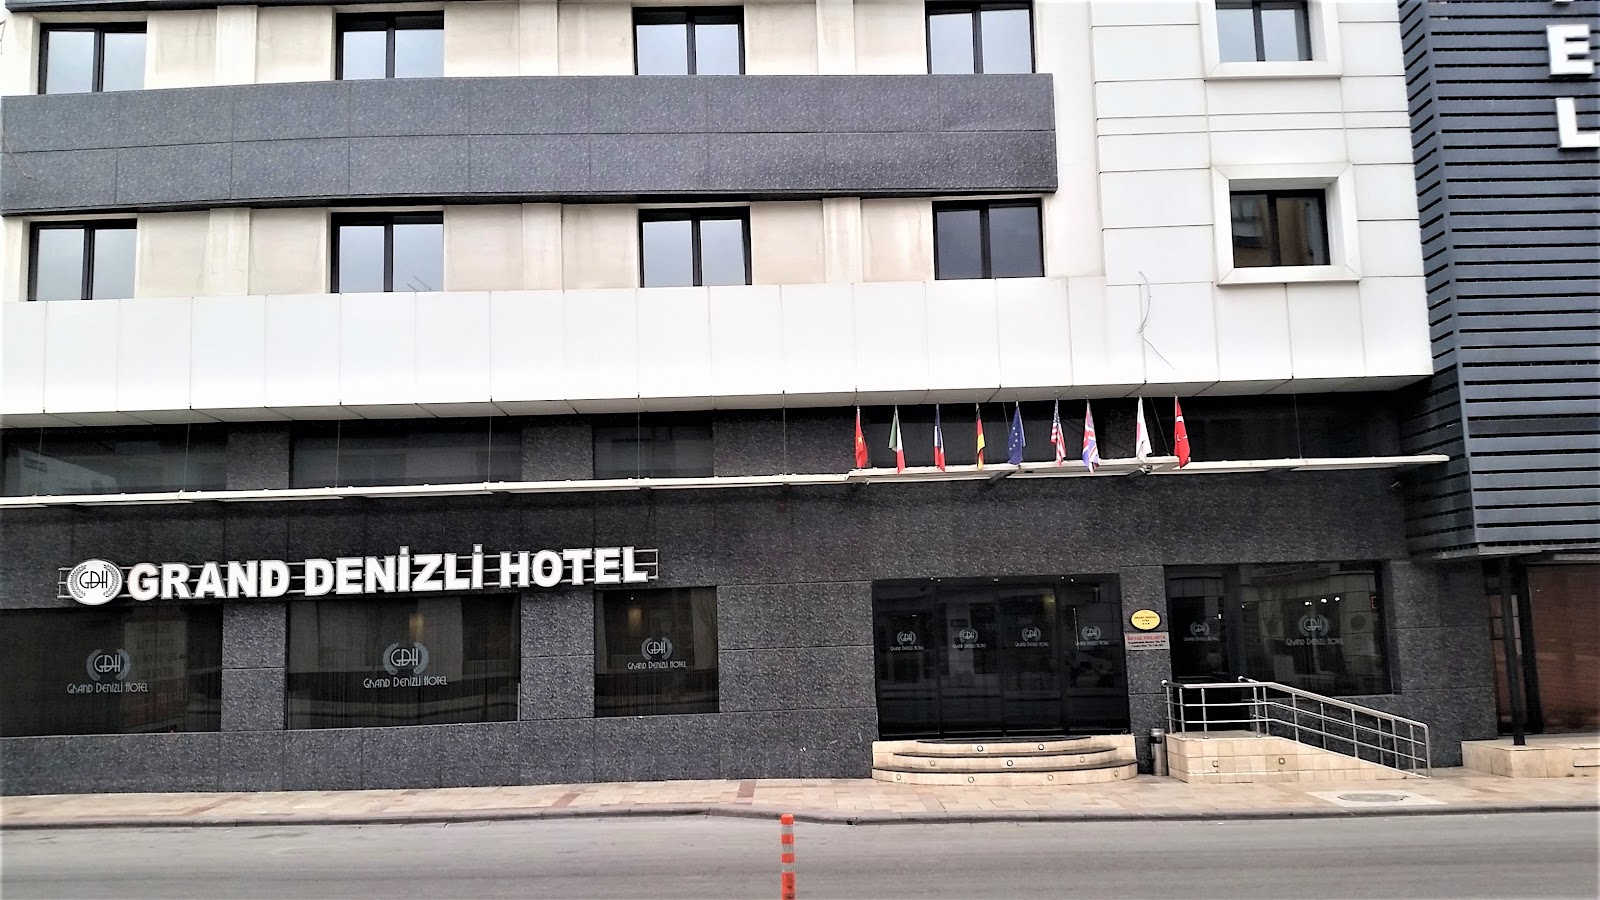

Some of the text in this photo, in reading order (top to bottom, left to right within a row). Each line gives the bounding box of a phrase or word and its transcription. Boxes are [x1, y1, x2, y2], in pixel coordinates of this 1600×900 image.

[1546, 0, 1600, 148] EL
[127, 543, 649, 601] GRAND DENİZLİ HOTEL
[66, 683, 93, 694] GRAND
[125, 682, 149, 693] HOTEL
[363, 677, 390, 689] GRAND
[423, 675, 448, 686] HOTEL
